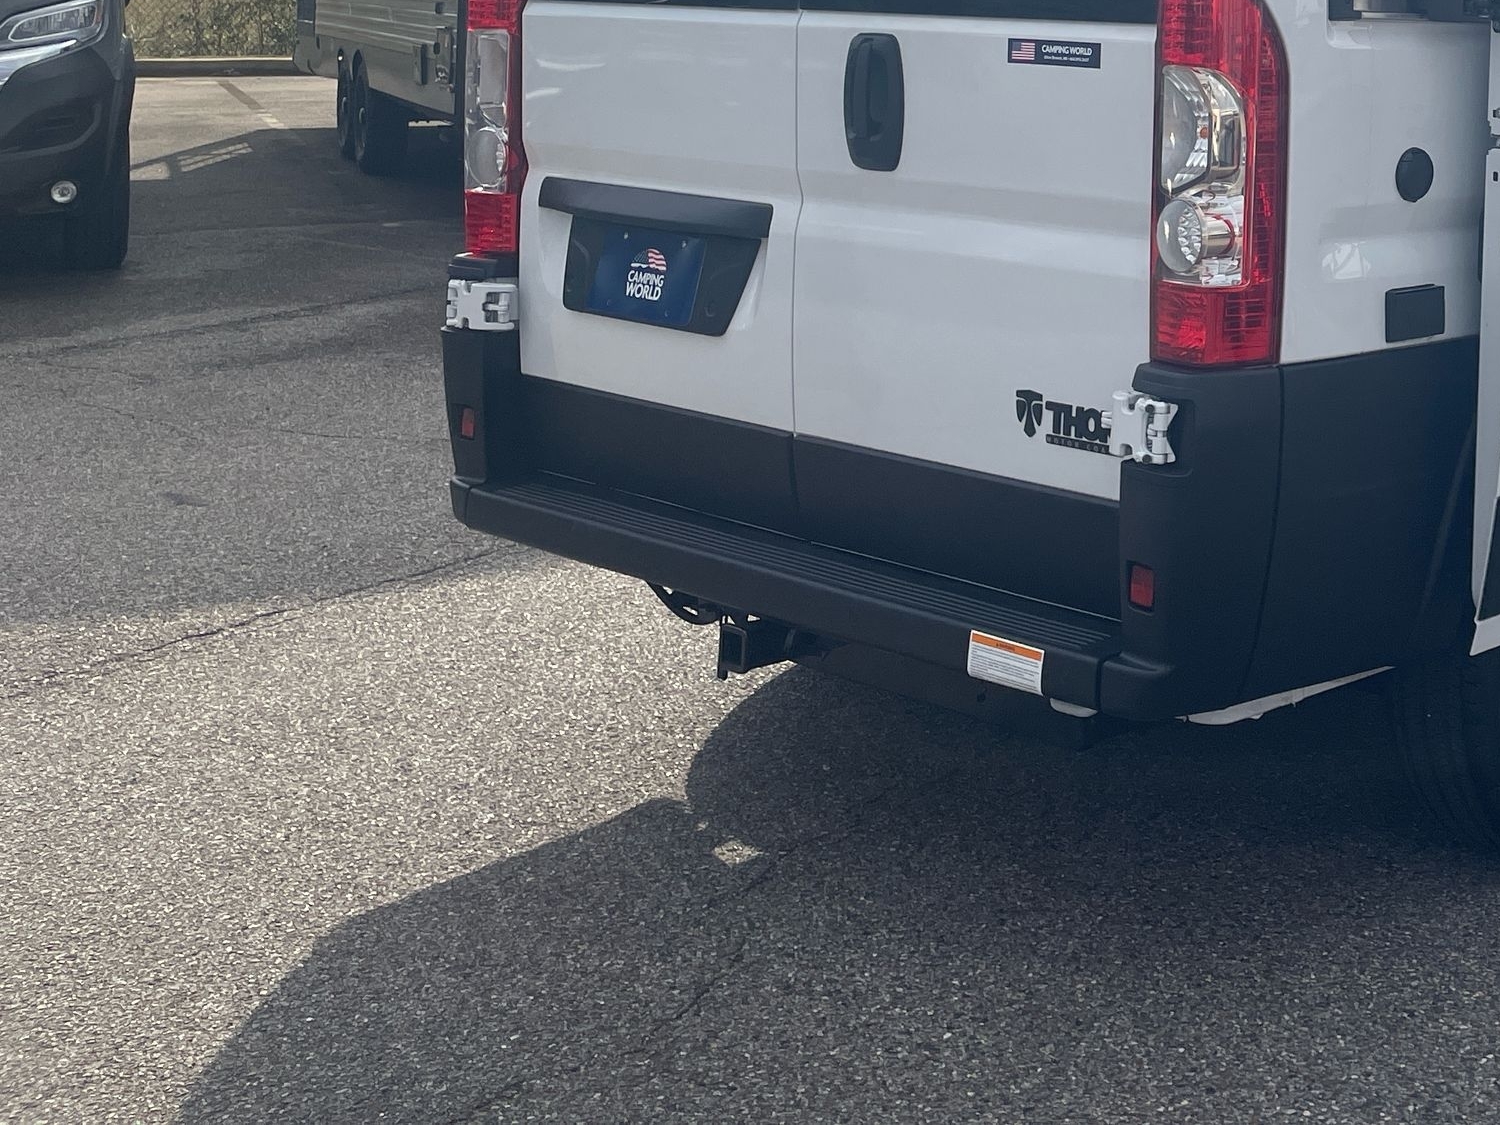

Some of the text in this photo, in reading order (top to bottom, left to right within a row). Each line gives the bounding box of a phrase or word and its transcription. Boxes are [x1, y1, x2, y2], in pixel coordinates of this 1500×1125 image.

[1041, 44, 1093, 56] CAMPING WORLD
[627, 269, 665, 288] CAMPING
[625, 281, 662, 301] WORLD
